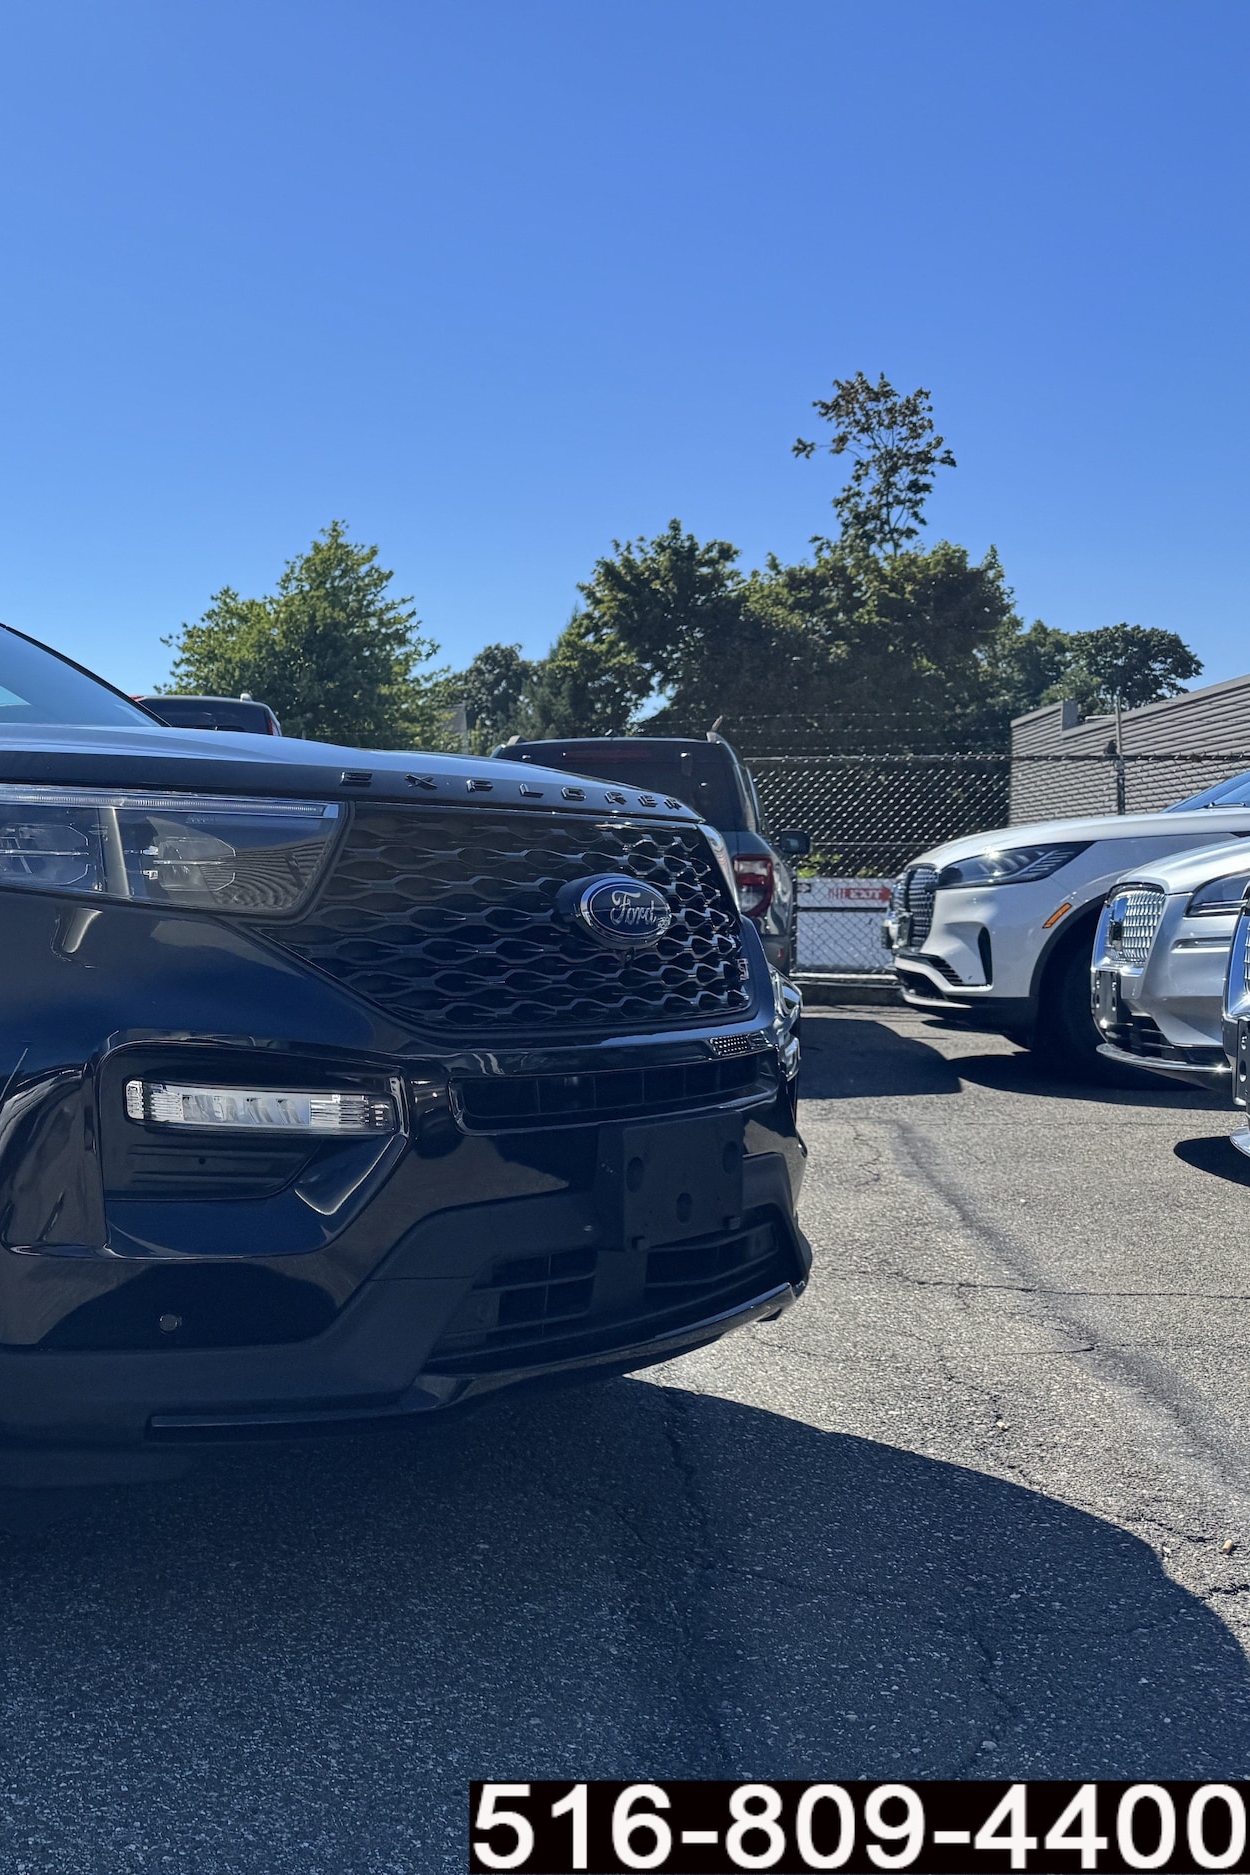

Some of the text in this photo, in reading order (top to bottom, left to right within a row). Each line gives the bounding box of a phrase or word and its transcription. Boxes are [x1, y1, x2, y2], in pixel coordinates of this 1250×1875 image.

[340, 770, 683, 811] EXPLORER
[610, 890, 657, 926] Ford
[850, 889, 881, 900] EXIT
